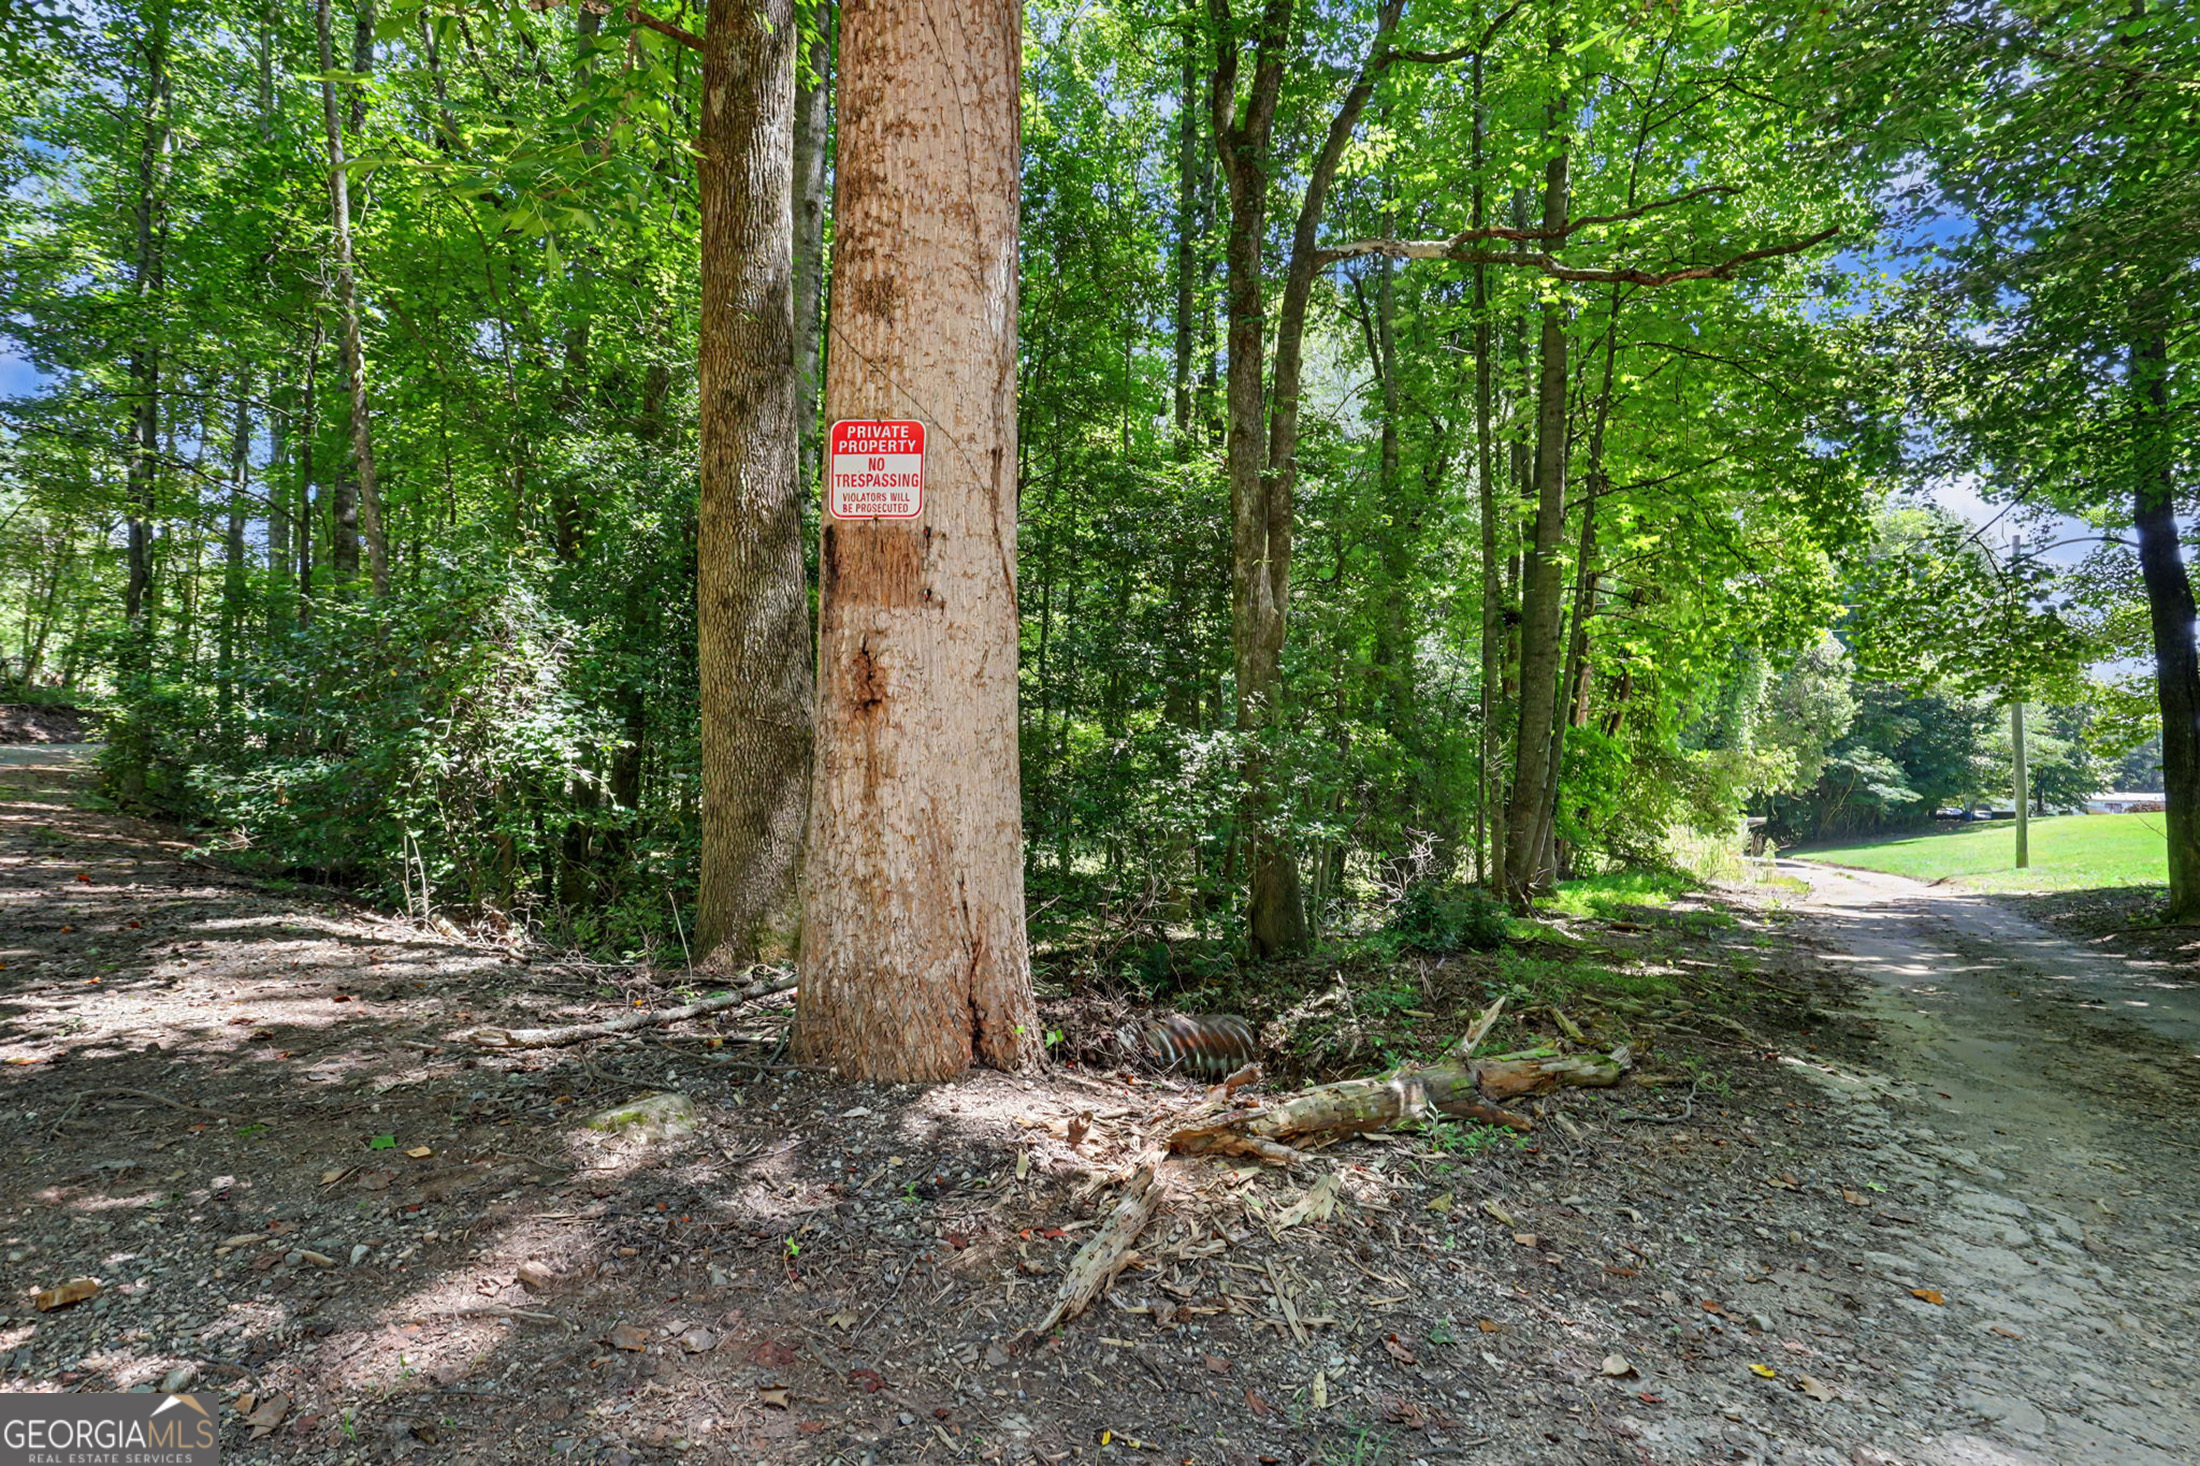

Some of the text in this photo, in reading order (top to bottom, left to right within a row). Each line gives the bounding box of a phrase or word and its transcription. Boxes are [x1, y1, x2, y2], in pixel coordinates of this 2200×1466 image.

[847, 425, 909, 439] PRIVATE
[838, 440, 916, 453] PROPERTY
[868, 457, 885, 471] NO
[835, 473, 919, 488] TRESPASSING
[842, 492, 910, 502] VIOLATORS WILL
[842, 503, 909, 513] BE PROSECUTED
